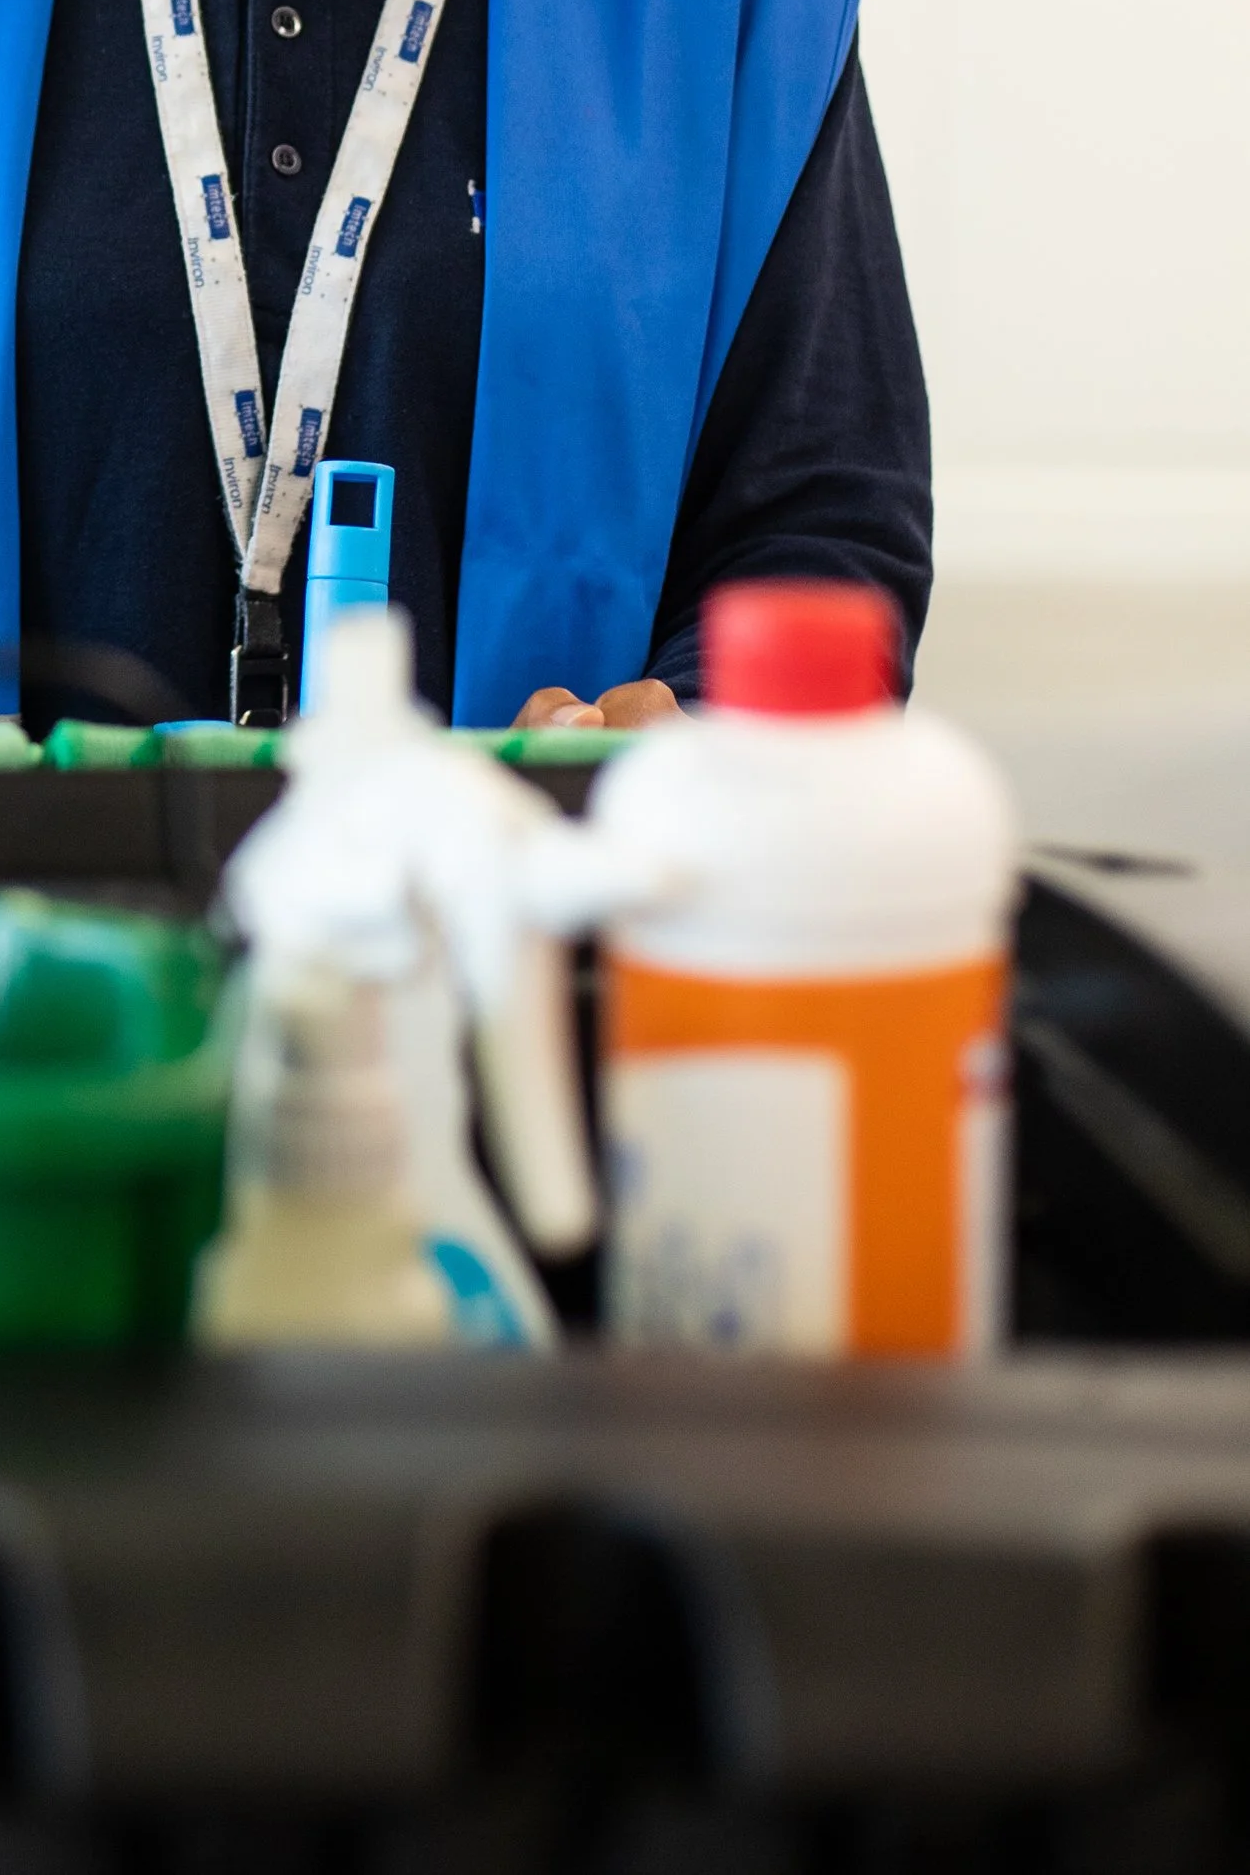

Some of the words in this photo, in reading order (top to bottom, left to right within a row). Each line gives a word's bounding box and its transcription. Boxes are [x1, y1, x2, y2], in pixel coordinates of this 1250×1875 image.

[153, 35, 168, 82] Inviron
[207, 184, 226, 227] Imtech
[342, 204, 367, 246] Imtech
[188, 236, 205, 288] Inviron
[302, 245, 323, 295] Inviron
[241, 401, 258, 446] Imtech
[301, 420, 318, 467] Imtech
[223, 457, 243, 509] Inviron
